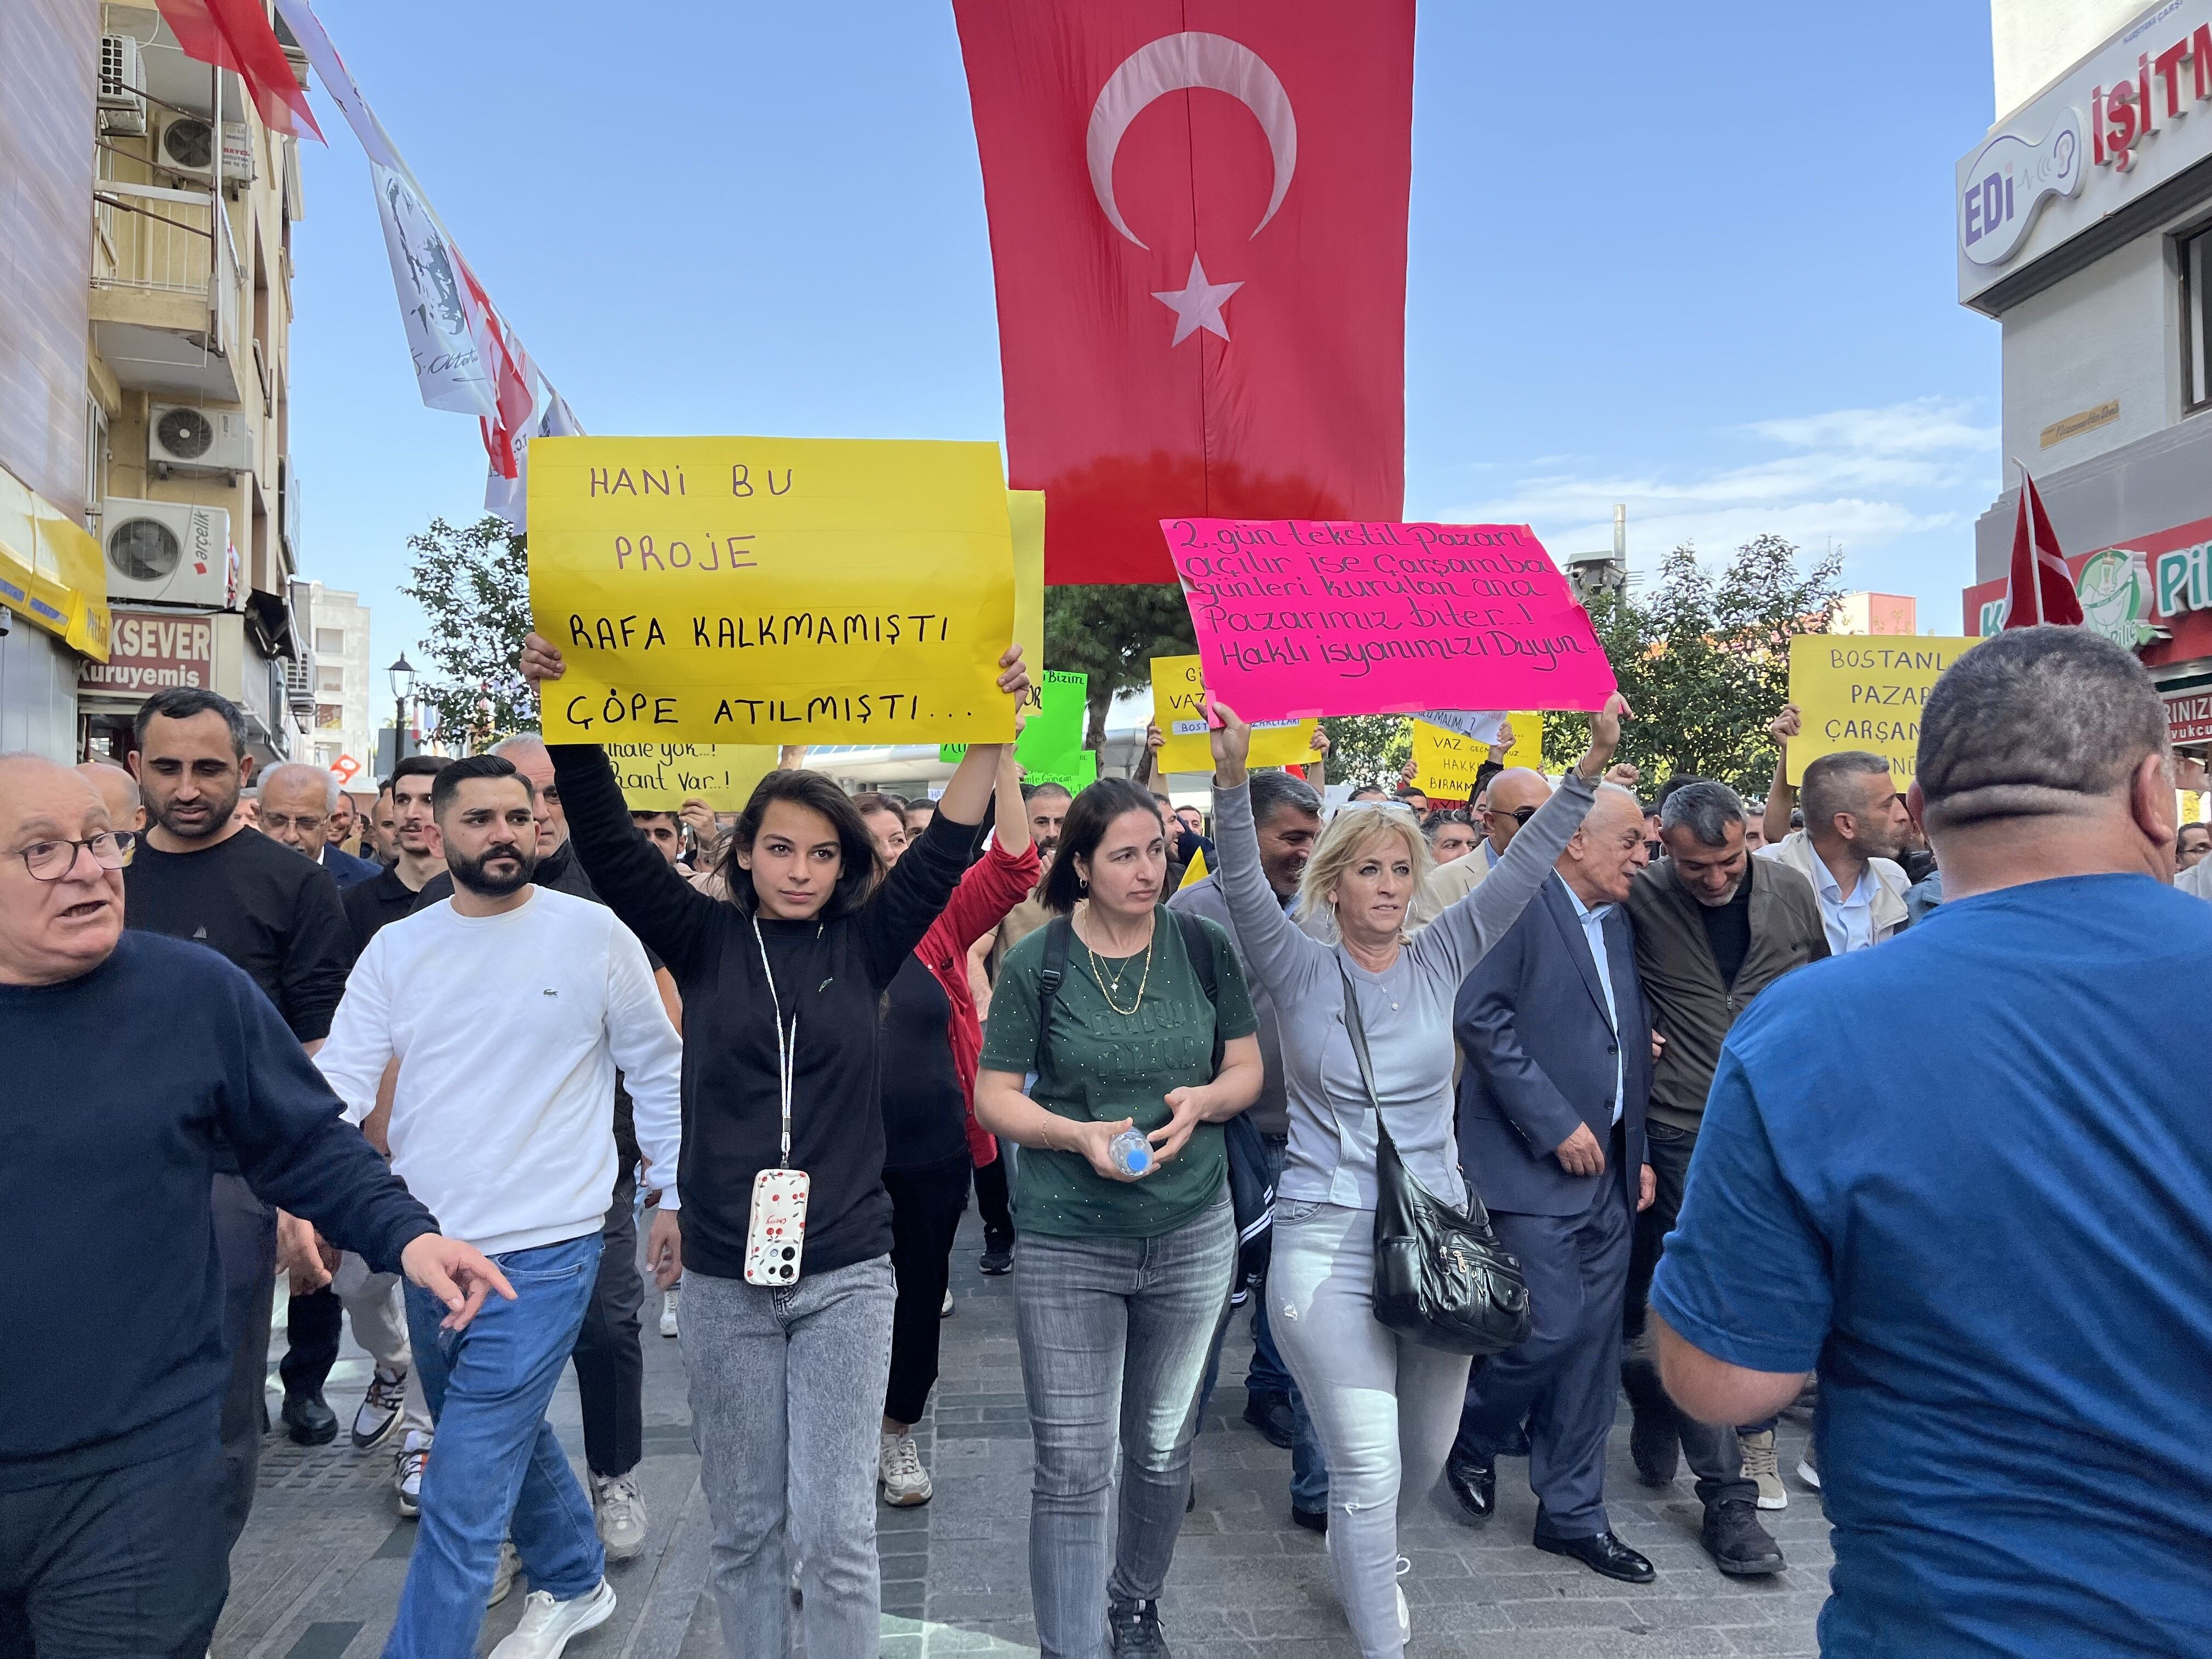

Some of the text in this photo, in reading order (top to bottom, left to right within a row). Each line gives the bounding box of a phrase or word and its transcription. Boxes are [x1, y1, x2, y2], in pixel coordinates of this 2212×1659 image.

[732, 464, 792, 498] BU
[194, 510, 212, 561] arçelik
[1185, 550, 1554, 577] açılır ise Çarşamba
[1195, 575, 1548, 606] günleri kurulan ana
[569, 612, 947, 650] RAFA KALKMAMIŞTI
[1199, 605, 1403, 634] Pazarımız
[1220, 636, 1311, 672] Haklı
[1048, 670, 1085, 685] Bizim
[1433, 736, 1462, 751] VAZ
